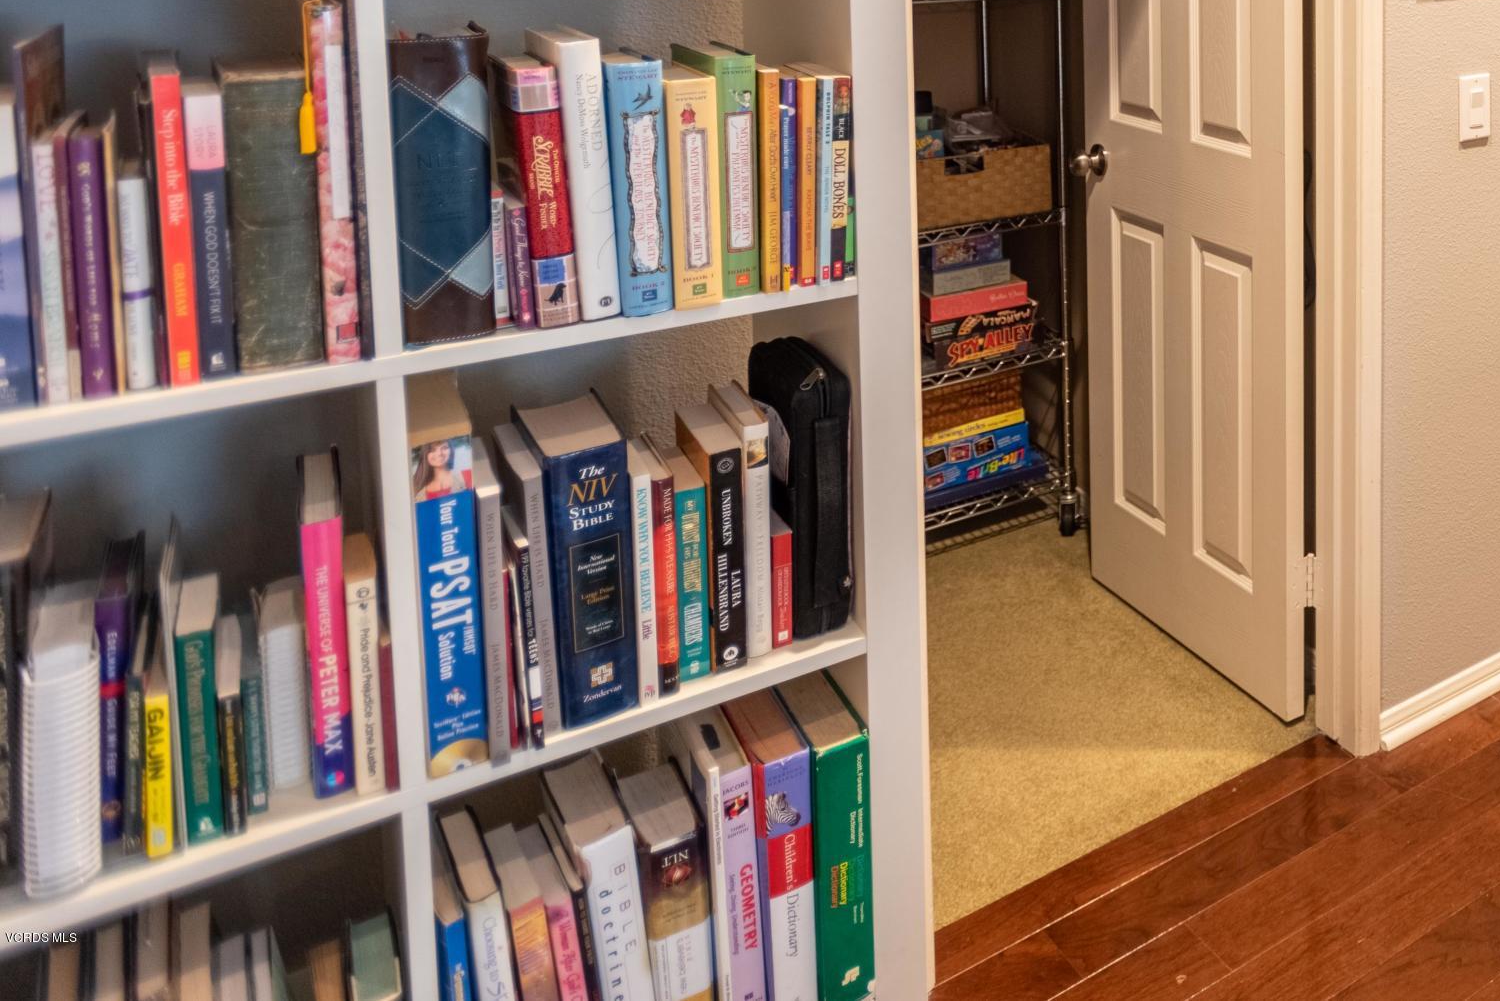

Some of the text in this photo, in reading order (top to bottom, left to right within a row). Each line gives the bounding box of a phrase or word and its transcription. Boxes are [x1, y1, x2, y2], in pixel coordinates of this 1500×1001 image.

[585, 72, 604, 153] ADORNED
[158, 109, 186, 226] Step into the Bible
[832, 148, 847, 219] DOLL BONES
[203, 190, 217, 224] WHEN
[204, 225, 219, 250] GOD
[769, 211, 779, 264] JIM GEORGE
[172, 262, 189, 318] GRAHAM
[208, 297, 222, 313] FIX
[947, 322, 1035, 368] SPY ALLEY
[567, 472, 619, 507] NIV
[578, 465, 606, 480] The
[438, 499, 457, 525] Your
[662, 487, 672, 513] MADE
[720, 488, 732, 546] UNBROKEN
[440, 527, 460, 557] Total
[637, 488, 652, 613] KNOW WHY YOU BELIEVE
[428, 556, 473, 631] PSAT
[717, 552, 729, 632] HILLENBRAND
[731, 569, 742, 608] LAURA
[360, 627, 371, 652] Pride
[642, 618, 652, 641] Little
[684, 602, 703, 646] CHAMBERS
[314, 566, 344, 755] THE UNIVERSE OF PETER MAX
[362, 653, 372, 673] and
[437, 631, 455, 681] Solution
[583, 683, 623, 704] Zondervan
[367, 747, 378, 776] Austen
[722, 780, 749, 797] JACOBS
[661, 849, 689, 868] NLT
[783, 833, 799, 958] Children's Dictionary
[839, 862, 848, 905] Dictionary
[739, 864, 758, 950] GEOMETRY
[482, 916, 500, 969] Choosing
